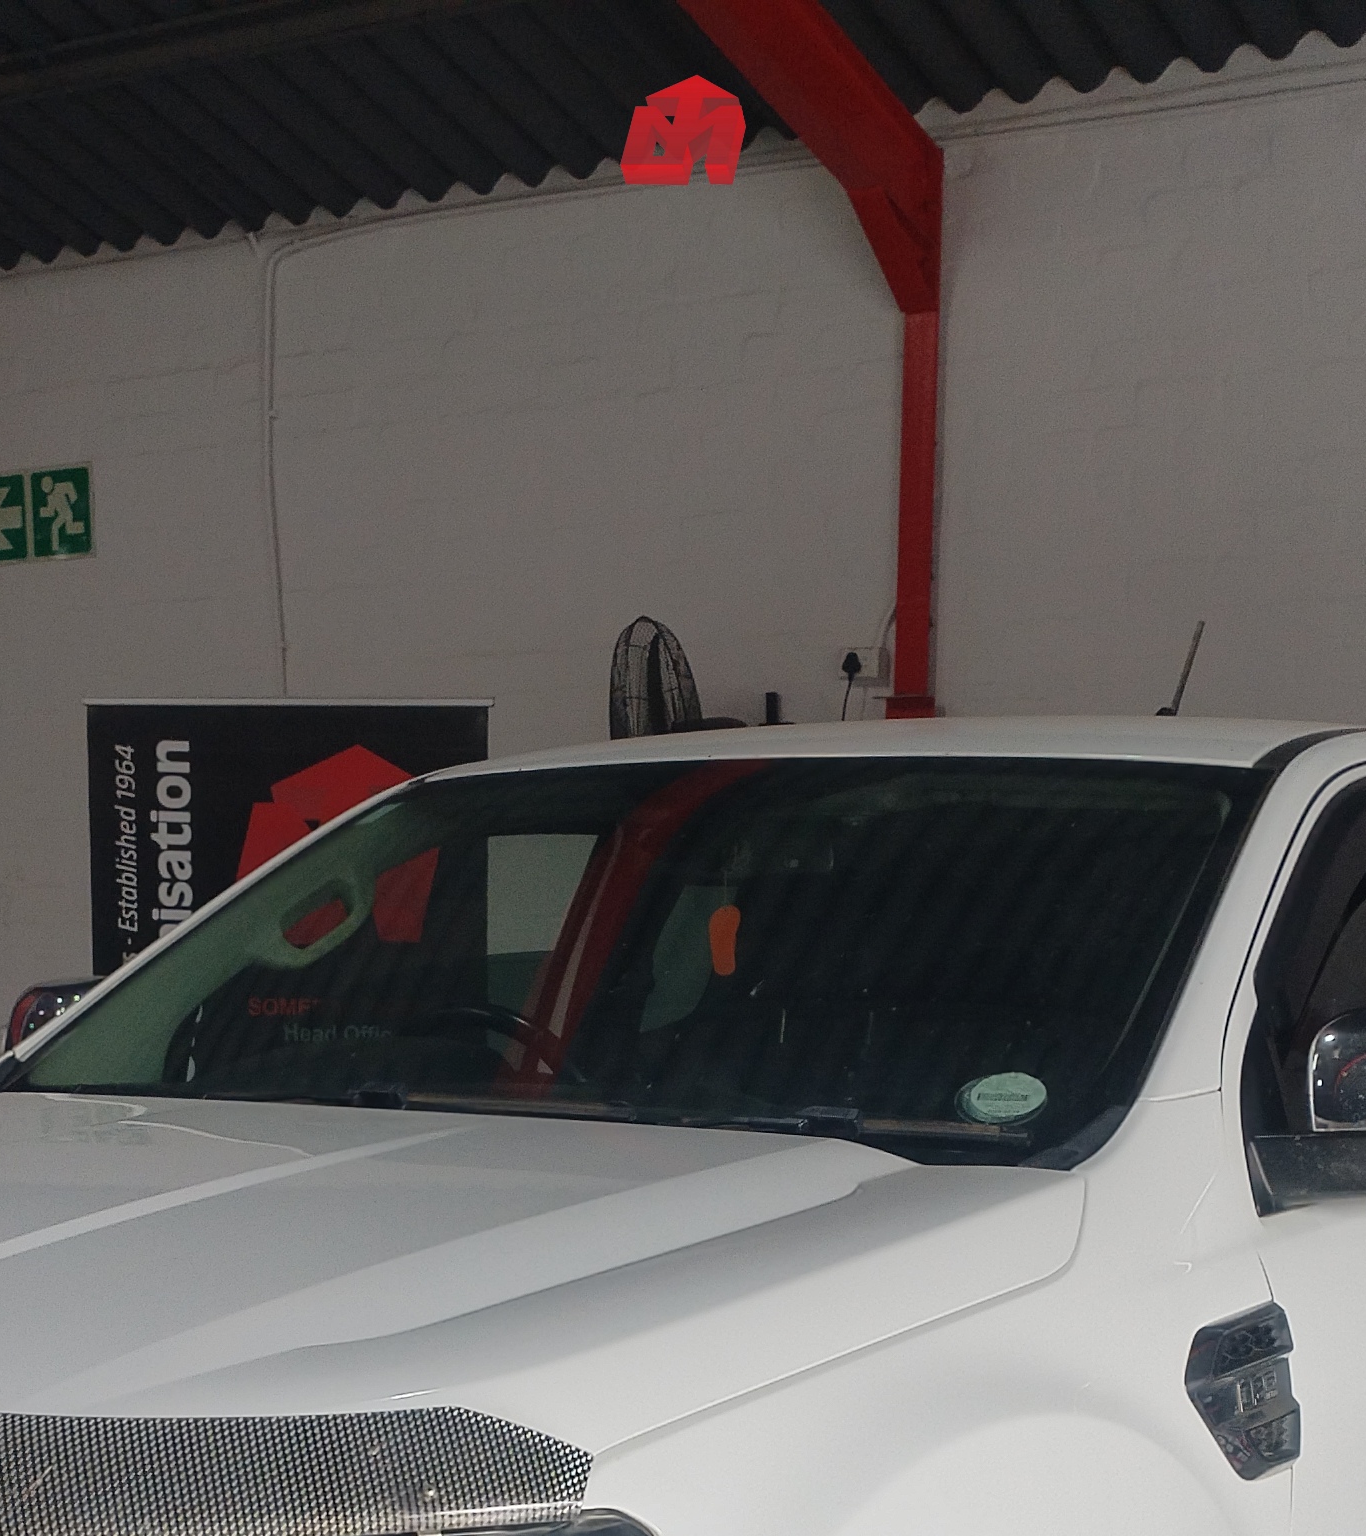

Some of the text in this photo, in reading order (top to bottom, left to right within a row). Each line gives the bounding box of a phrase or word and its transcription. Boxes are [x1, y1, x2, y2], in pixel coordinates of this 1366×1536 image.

[114, 744, 136, 799] 1964
[114, 804, 139, 932] Established
[150, 739, 193, 938] isation
